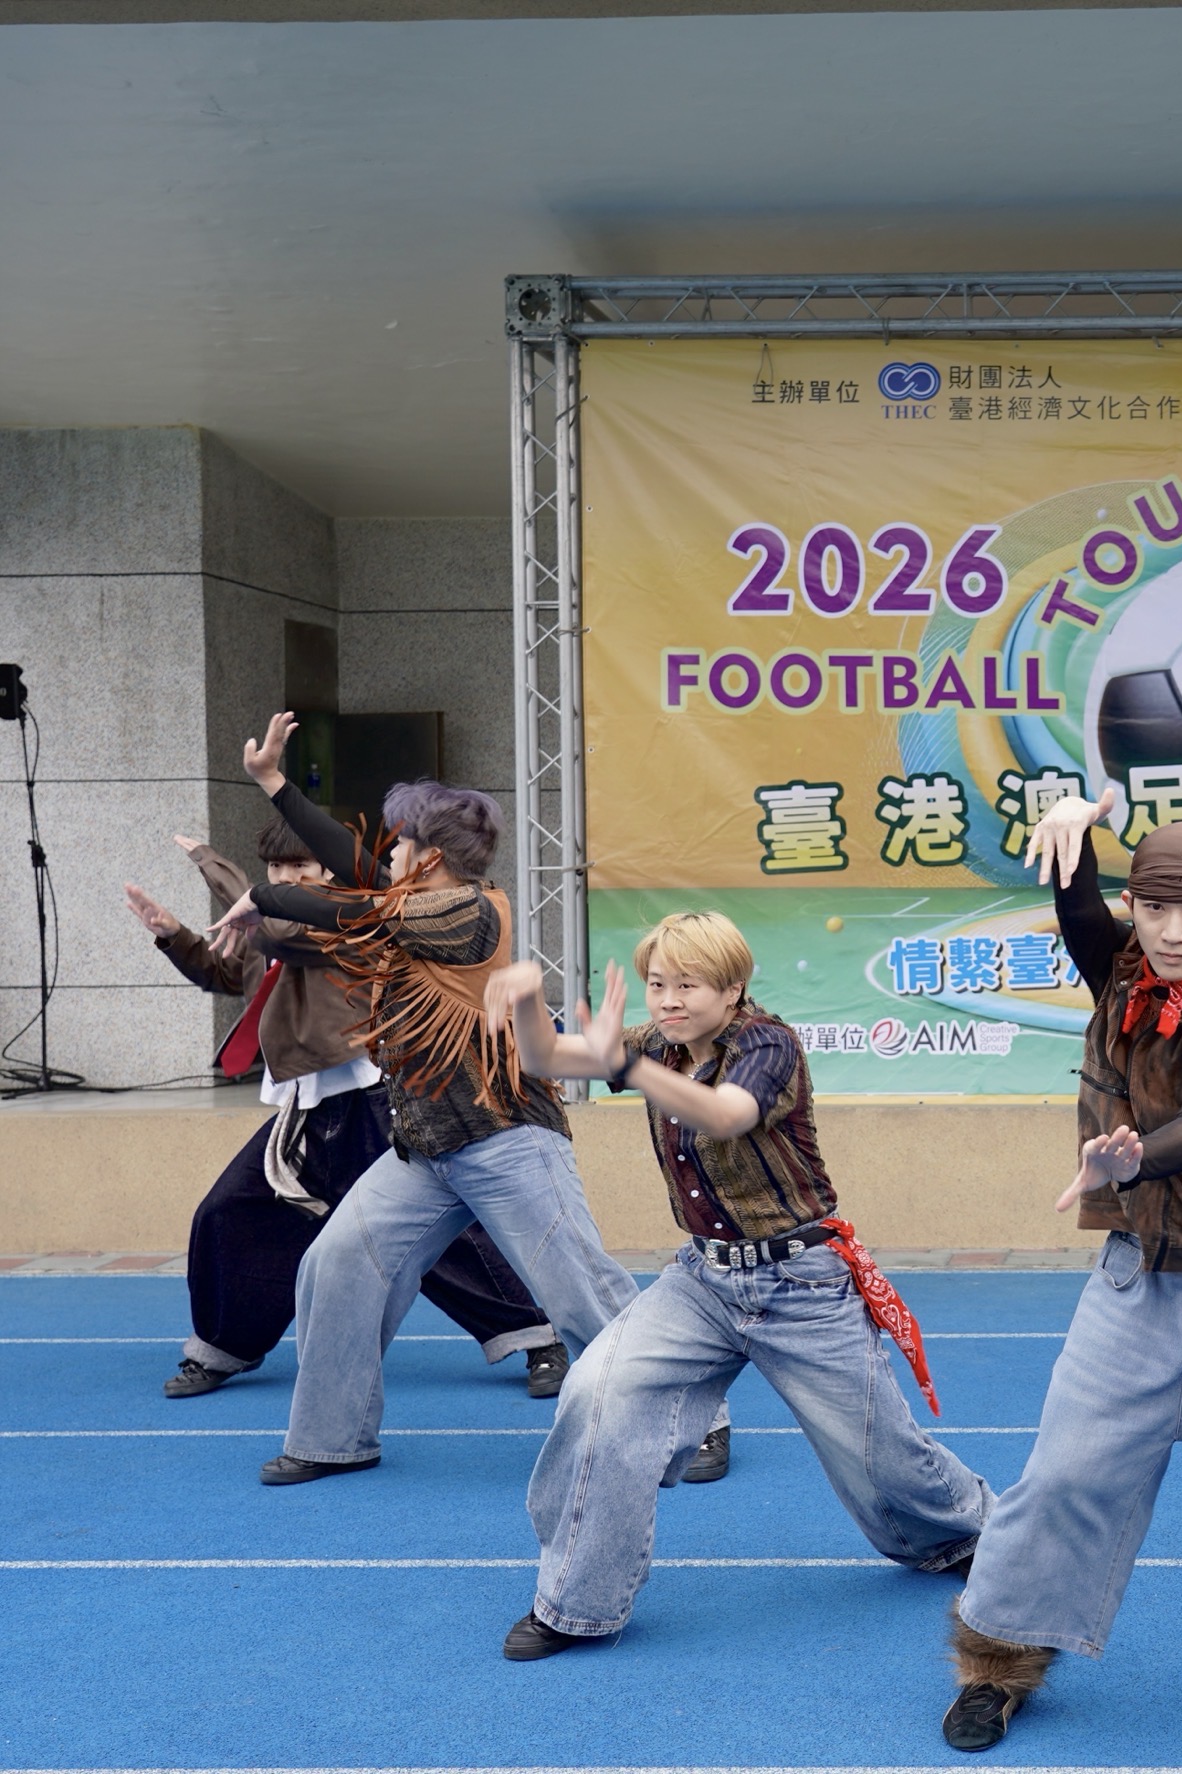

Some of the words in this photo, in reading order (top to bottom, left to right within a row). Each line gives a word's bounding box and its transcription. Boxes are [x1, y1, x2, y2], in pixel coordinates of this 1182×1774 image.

[948, 365, 1063, 390] 財團法人
[751, 379, 860, 404] 主辦單位
[880, 404, 938, 420] THEC
[728, 524, 1007, 616] 2026
[665, 651, 1062, 712] FOOTBALL
[912, 1023, 977, 1051] AIM
[980, 1023, 1017, 1033] Creative
[980, 1033, 1010, 1043] Sports
[980, 1043, 1008, 1053] Group
